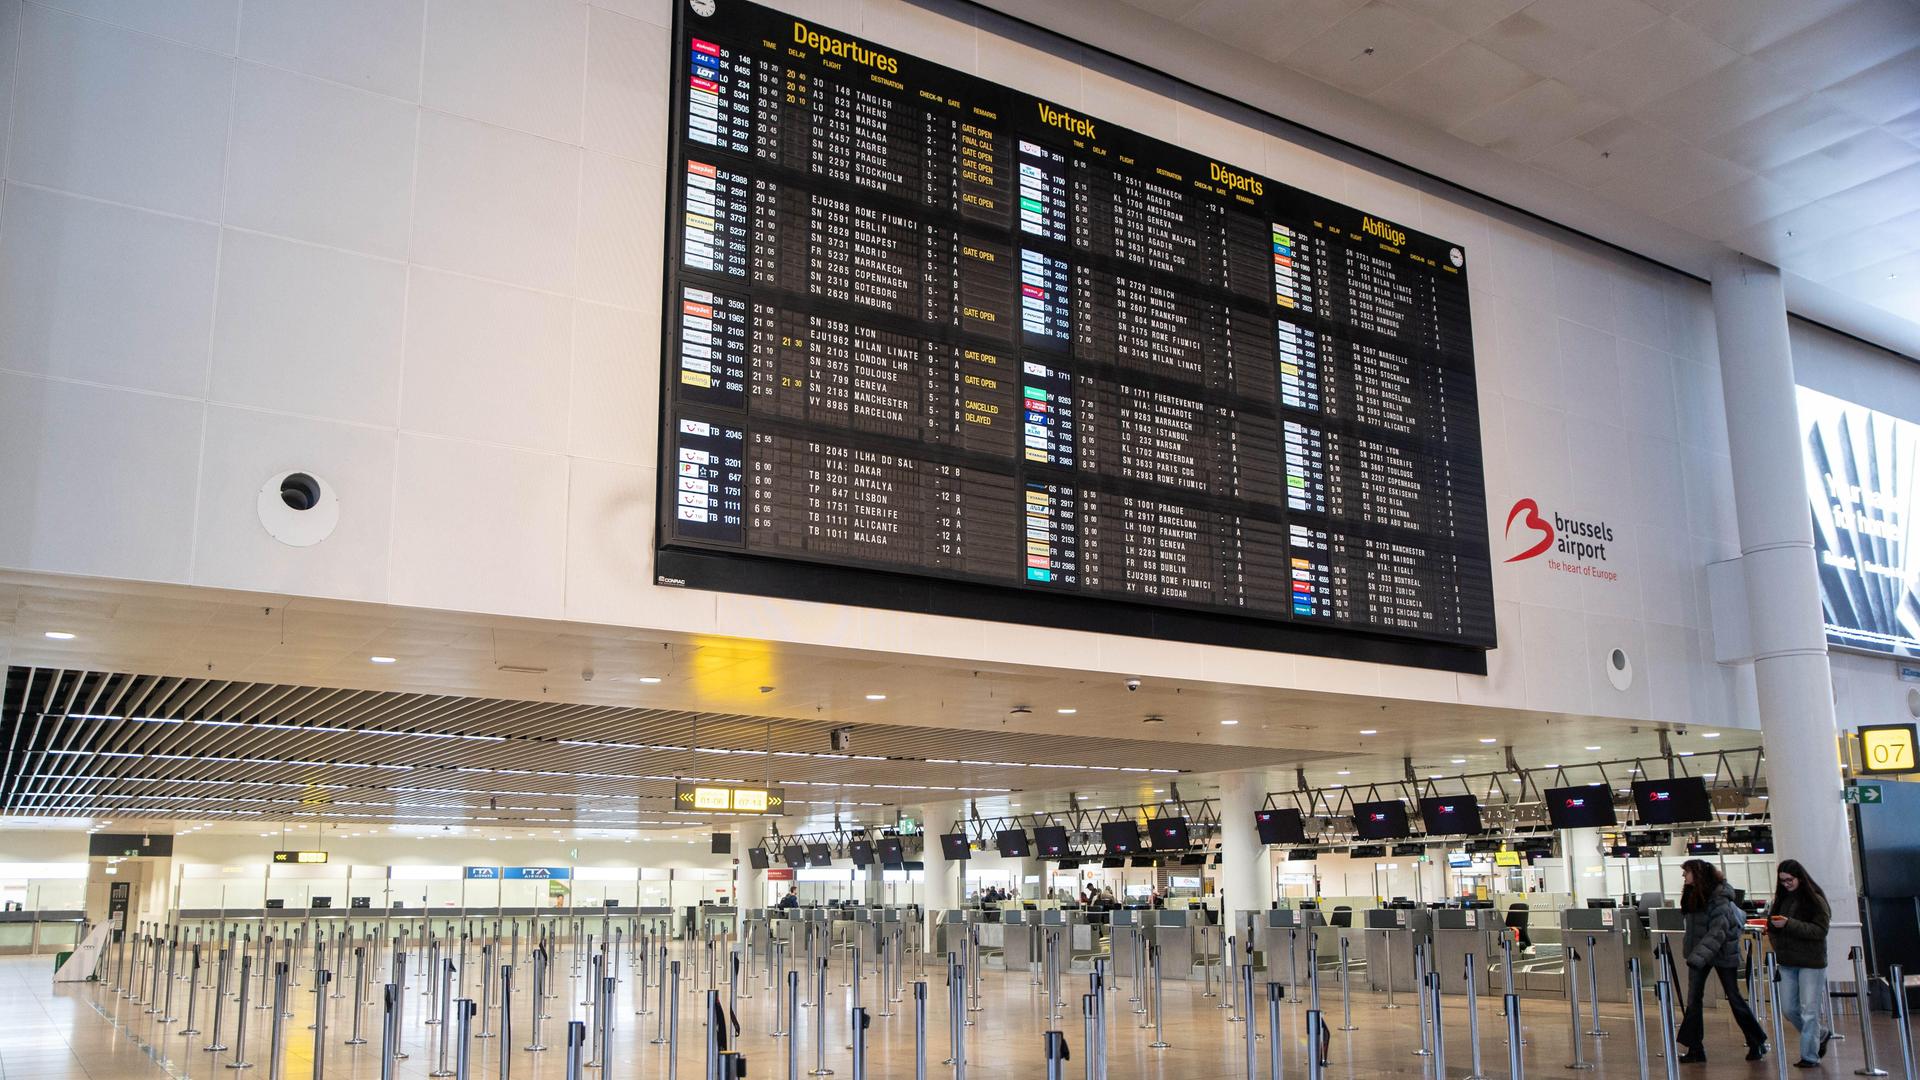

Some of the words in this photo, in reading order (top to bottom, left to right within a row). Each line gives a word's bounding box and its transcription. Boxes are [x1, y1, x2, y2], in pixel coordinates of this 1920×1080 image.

[794, 22, 898, 74] Departures
[763, 40, 776, 49] TIME
[788, 48, 805, 58] DELAY
[823, 59, 841, 70] FLIGHT
[871, 74, 903, 89] DESTINATION
[919, 90, 942, 102] CHECK-IN
[948, 99, 960, 108] GATE
[813, 77, 823, 87] 30
[836, 85, 850, 96] 148
[856, 91, 891, 108] TANGIER
[962, 124, 976, 134] GATE
[977, 128, 992, 139] OPEN
[813, 90, 823, 100] A3
[835, 96, 850, 107] 623
[856, 103, 886, 119] ATHENS
[962, 135, 978, 146] FINAL
[979, 140, 993, 151] CALL
[1038, 102, 1096, 139] Vertrek
[813, 102, 823, 112] LO
[835, 109, 850, 119] 234
[856, 115, 886, 130] WARSAW
[962, 147, 976, 157] GATE
[977, 151, 992, 162] OPEN
[813, 114, 823, 123] VY
[829, 119, 849, 131] 2151
[855, 127, 886, 142] MALAGA
[962, 158, 977, 169] GATE
[978, 163, 993, 173] OPEN
[812, 139, 823, 149] SN
[829, 143, 850, 156] 2815
[856, 151, 886, 167] PRAGUE
[812, 126, 823, 136] OU
[829, 132, 850, 143] 4457
[856, 139, 886, 154] ZAGREB
[962, 170, 977, 181] GATE
[978, 174, 993, 185] OPEN
[812, 163, 822, 173] SN
[829, 168, 849, 181] 2559
[855, 176, 886, 190] WARSAW
[812, 151, 823, 161] SN
[829, 156, 849, 168] 2297
[855, 163, 902, 183] STOCKHOLM
[962, 193, 977, 204] GATE
[978, 198, 993, 208] OPEN
[1210, 162, 1263, 196] Départs
[812, 195, 849, 211] EJU2988
[855, 206, 876, 219] ROME
[882, 213, 916, 229] FIUMICI
[855, 231, 896, 248] BUDAPEST
[855, 219, 886, 234] BERLIN
[963, 247, 978, 257] GATE
[979, 251, 994, 261] OPEN
[1362, 216, 1406, 246] Abflüge
[855, 244, 886, 258] MADRID
[855, 256, 902, 274] MARRAKECH
[855, 269, 907, 288] COPENHAGEN
[854, 282, 896, 298] GOTEBORG
[963, 307, 978, 318] GATE
[979, 311, 995, 321] OPEN
[854, 294, 891, 310] HAMBURG
[810, 330, 848, 345] EJU1962
[854, 339, 881, 352] MILAN
[887, 346, 918, 360] LINATE
[855, 326, 876, 338] LYON
[965, 350, 979, 360] GATE
[980, 353, 996, 364] OPEN
[855, 353, 886, 366] LONDON
[892, 360, 908, 371] LHR
[965, 375, 979, 385] GATE
[980, 378, 996, 388] OPEN
[855, 365, 897, 381] TOULOUSE
[854, 378, 886, 392] GENEVA
[965, 400, 998, 413] CANCELLED
[854, 392, 907, 409] MANCHESTER
[965, 413, 991, 425] DELAYED
[854, 404, 902, 421] BARCELONA
[826, 459, 847, 470] VIA:
[854, 464, 881, 476] DAKAR
[855, 451, 875, 462] ILHA
[881, 455, 892, 465] DO
[898, 458, 913, 468] SAL
[854, 478, 892, 491] ANTALYA
[855, 492, 887, 504] LISBON
[854, 519, 897, 532] ALICANTE
[855, 505, 897, 519] TENERIFE
[1554, 511, 1613, 542] brussels
[854, 532, 886, 544] MALAGA
[1557, 534, 1606, 561] airport
[1548, 559, 1561, 571] the
[1562, 562, 1581, 576] heart
[1583, 565, 1591, 576] of
[1592, 566, 1617, 581] Europe
[1873, 743, 1905, 763] 07
